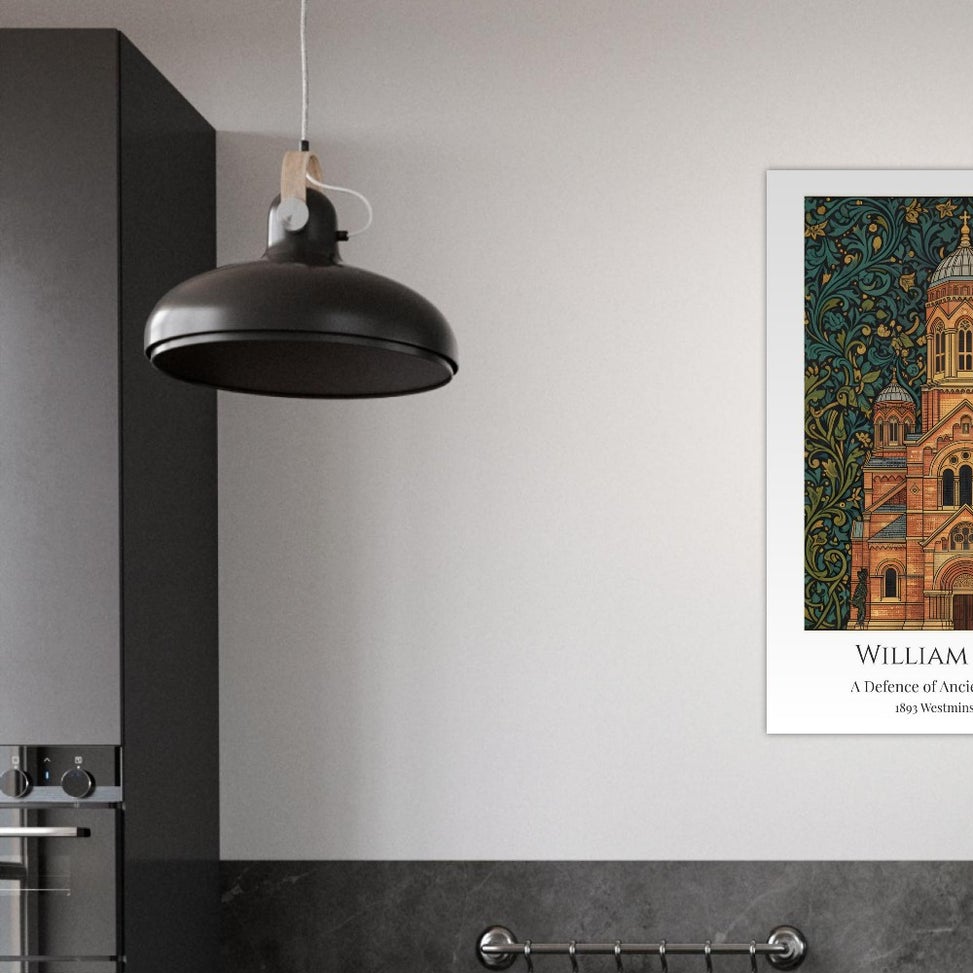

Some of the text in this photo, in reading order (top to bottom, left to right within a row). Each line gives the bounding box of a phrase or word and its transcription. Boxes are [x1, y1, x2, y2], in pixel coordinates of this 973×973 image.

[856, 644, 968, 665] WILLIAM
[850, 680, 860, 693] A
[864, 680, 919, 693] Defence
[923, 680, 937, 693] of
[895, 703, 918, 714] 1893
